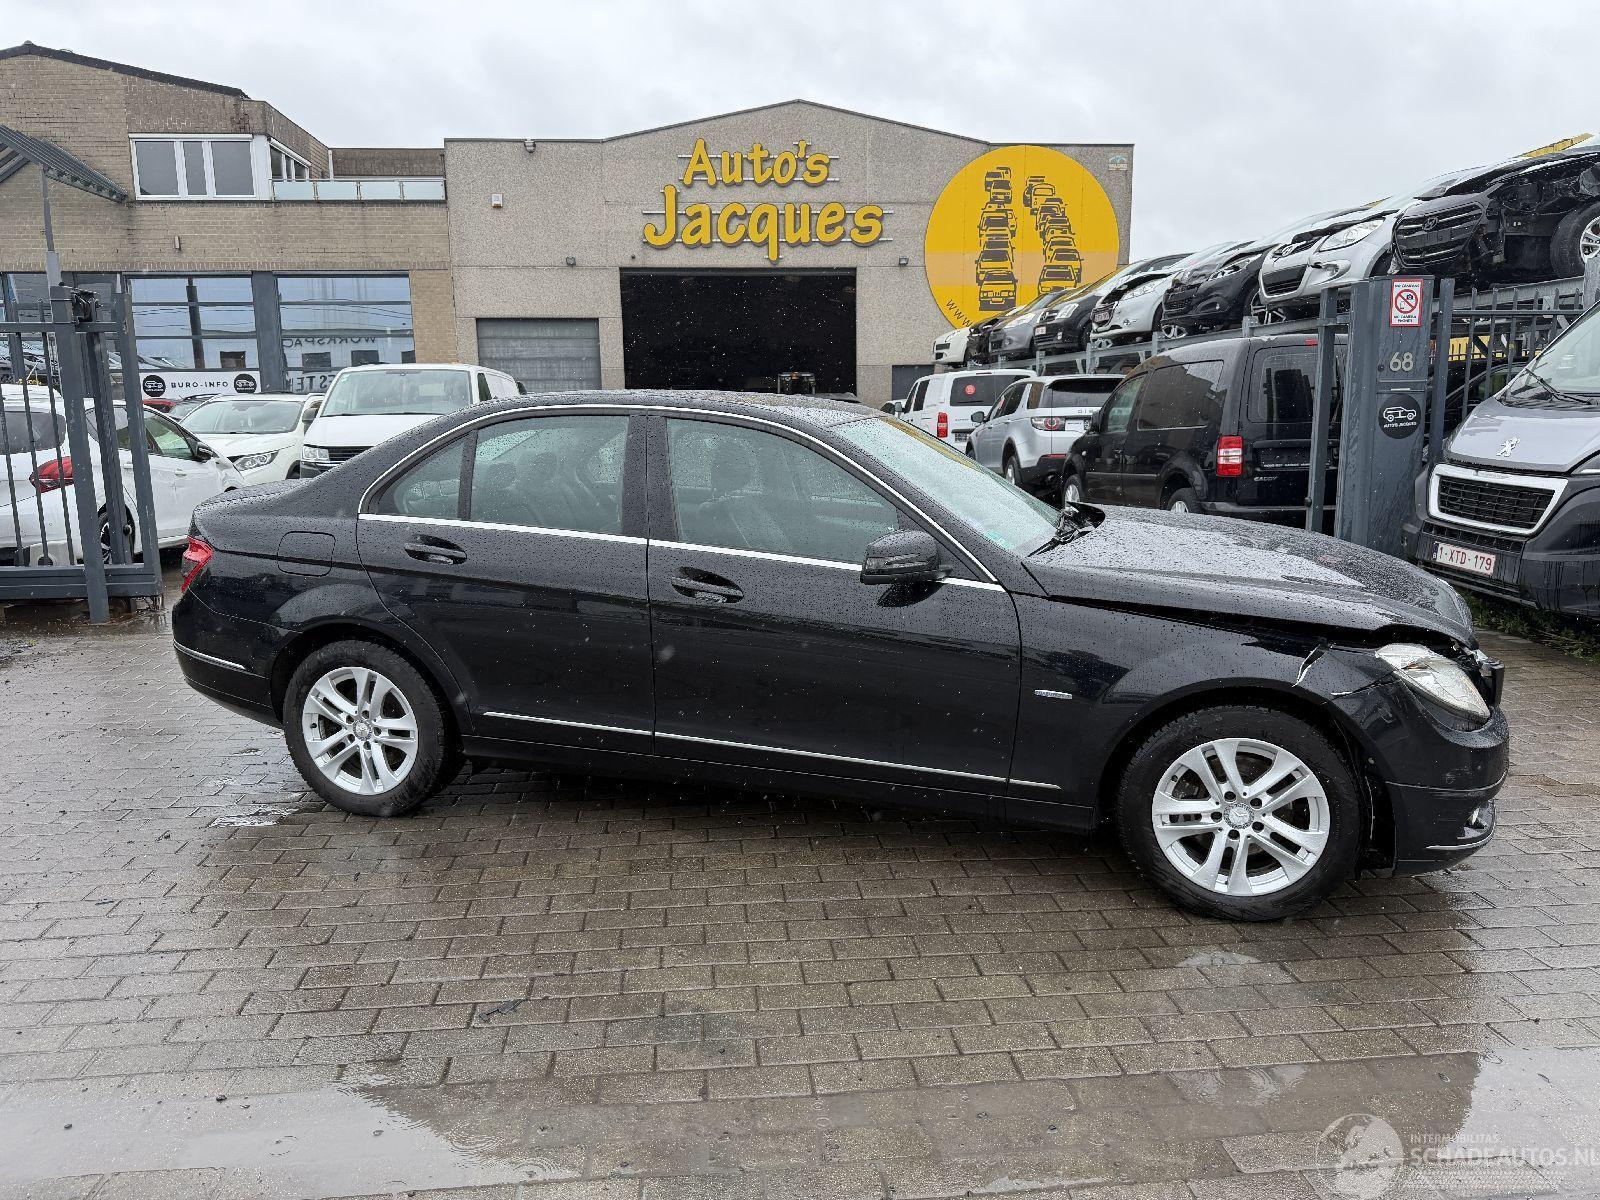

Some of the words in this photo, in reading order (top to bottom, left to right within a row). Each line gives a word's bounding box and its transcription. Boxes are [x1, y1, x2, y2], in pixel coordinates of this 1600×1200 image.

[683, 138, 830, 187] Auto's
[643, 184, 884, 262] Jacques
[1389, 351, 1414, 372] 68
[171, 381, 229, 389] BURO-INFO
